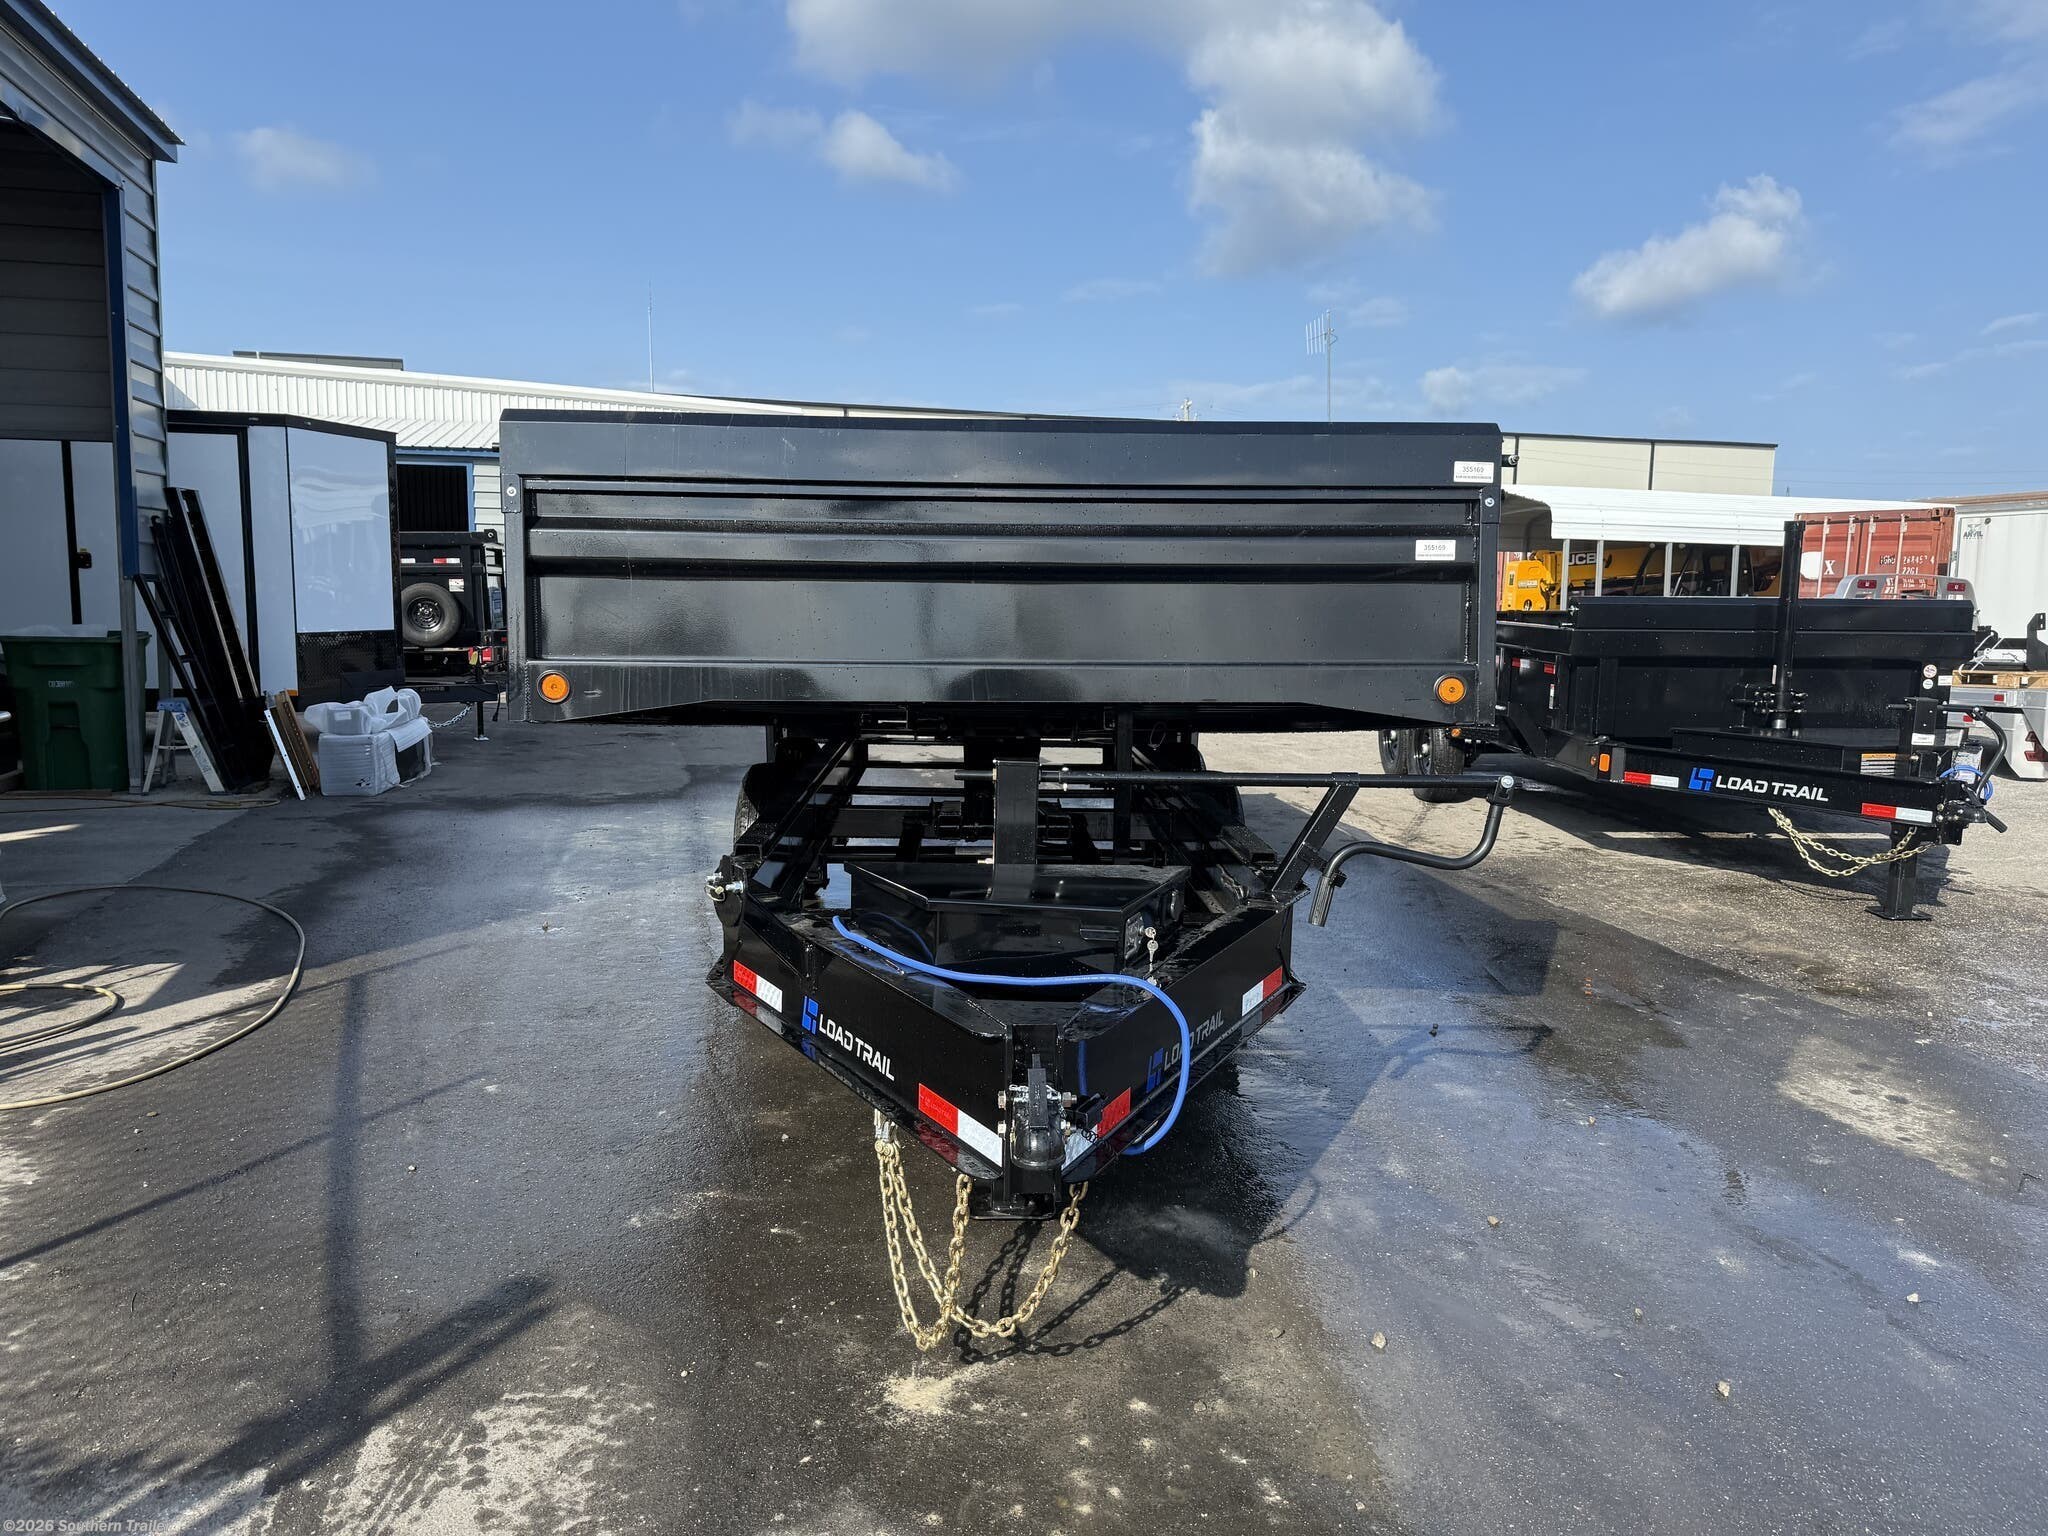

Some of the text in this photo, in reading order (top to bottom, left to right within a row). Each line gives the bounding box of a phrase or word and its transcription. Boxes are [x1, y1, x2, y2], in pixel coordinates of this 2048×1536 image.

[1715, 775, 1769, 794] LOAD
[1771, 782, 1829, 802] TRAIL
[818, 1013, 853, 1052] LOAD
[854, 1036, 895, 1082] TRAIL
[1164, 1031, 1195, 1071] LOD
[1196, 1010, 1224, 1044] TRAIL
